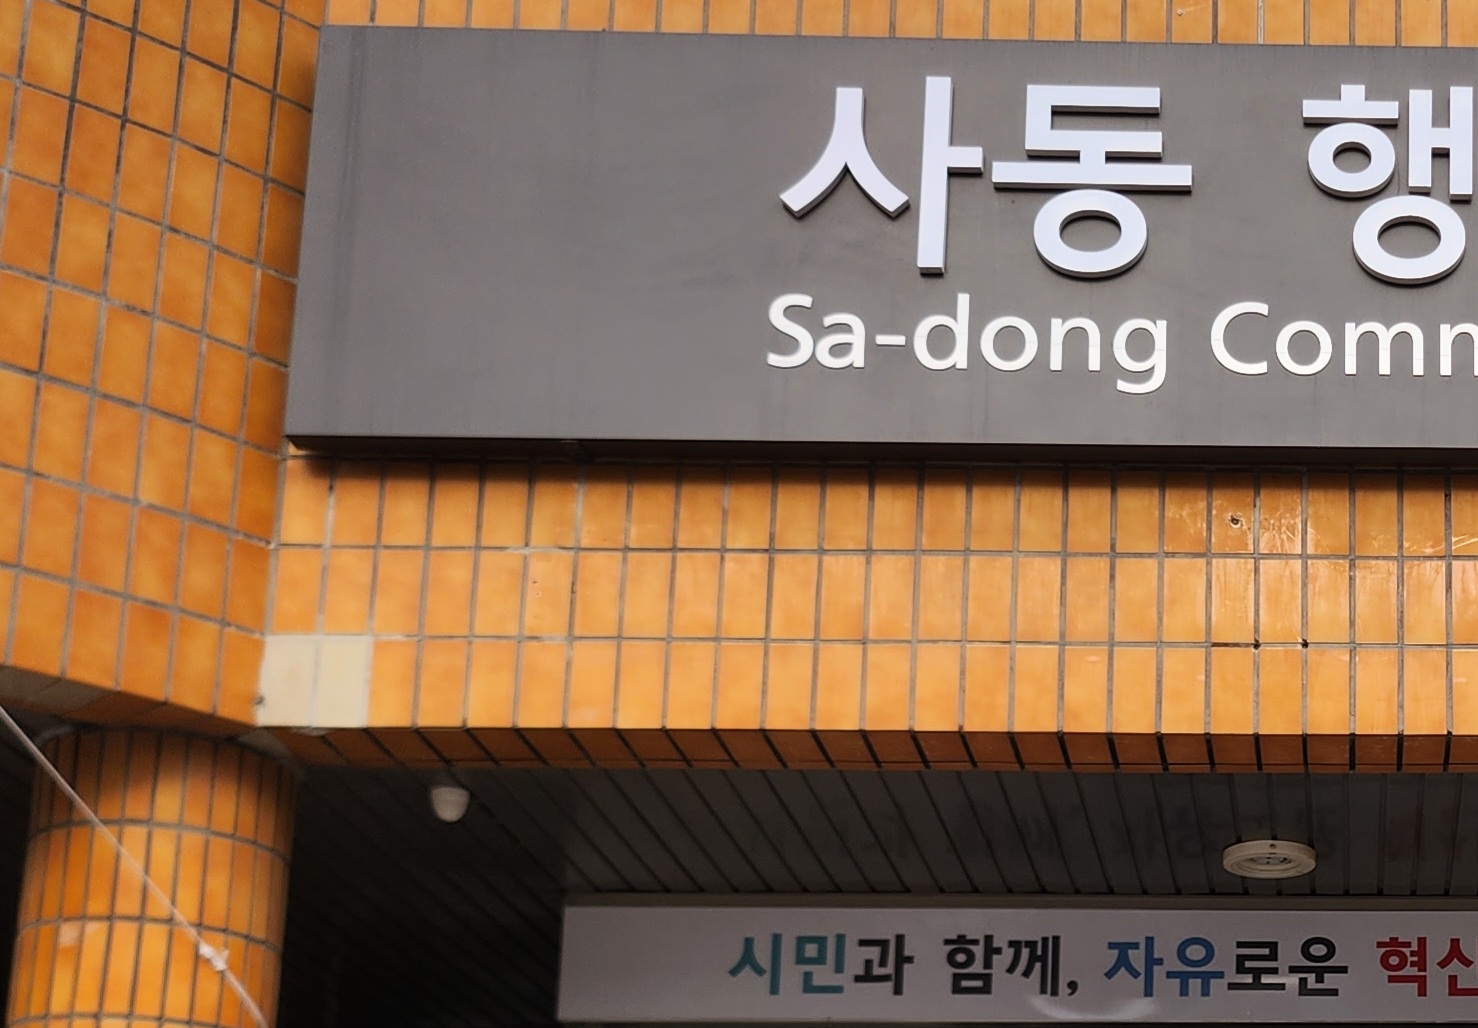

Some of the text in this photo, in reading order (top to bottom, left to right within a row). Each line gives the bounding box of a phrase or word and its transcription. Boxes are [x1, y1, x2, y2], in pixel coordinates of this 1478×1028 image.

[779, 76, 1194, 279] 사동
[766, 293, 1167, 394] Sa-dong
[728, 932, 914, 996] 시민과
[943, 934, 1079, 997] 함께,
[1103, 935, 1348, 998] 자유로운
